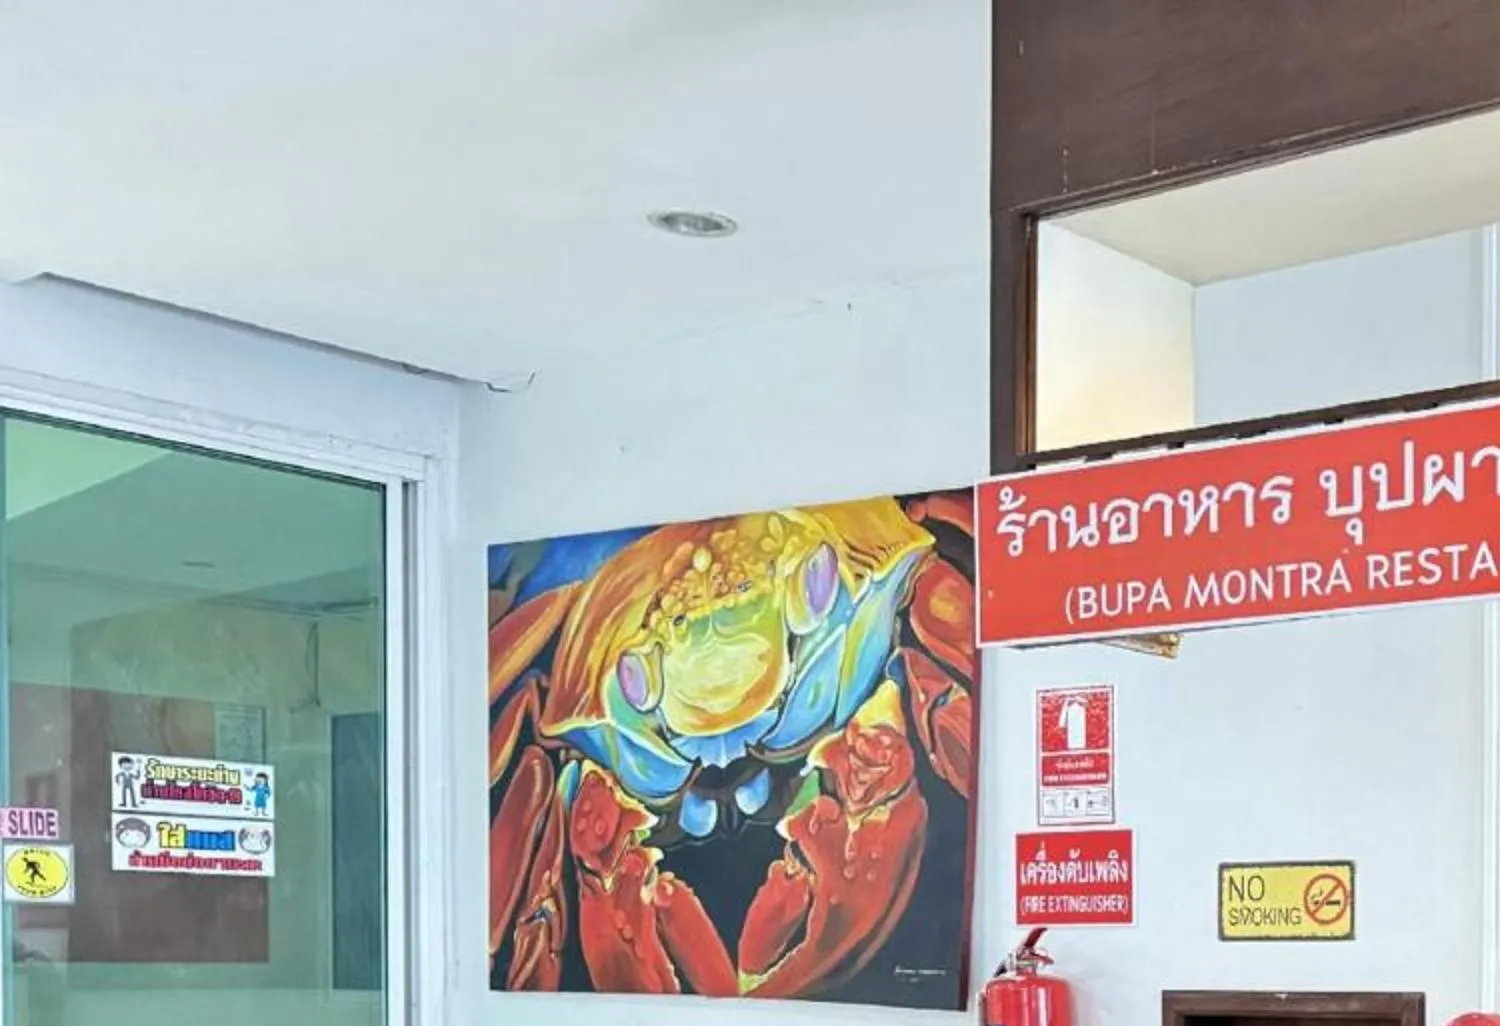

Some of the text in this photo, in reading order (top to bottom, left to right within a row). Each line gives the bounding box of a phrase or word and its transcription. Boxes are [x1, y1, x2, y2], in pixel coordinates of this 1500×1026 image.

[996, 475, 1295, 557] ร้านอาหาร
[1065, 577, 1172, 625] (BUPA
[1184, 557, 1353, 609] MONTRA
[8, 810, 57, 837] SLIDE
[1019, 842, 1129, 885] เครื่องดับเพลิง
[1228, 875, 1265, 902] NO
[1020, 893, 1128, 915] (FIRE EXTINGUISHER)
[1228, 906, 1301, 927] SMOKING
